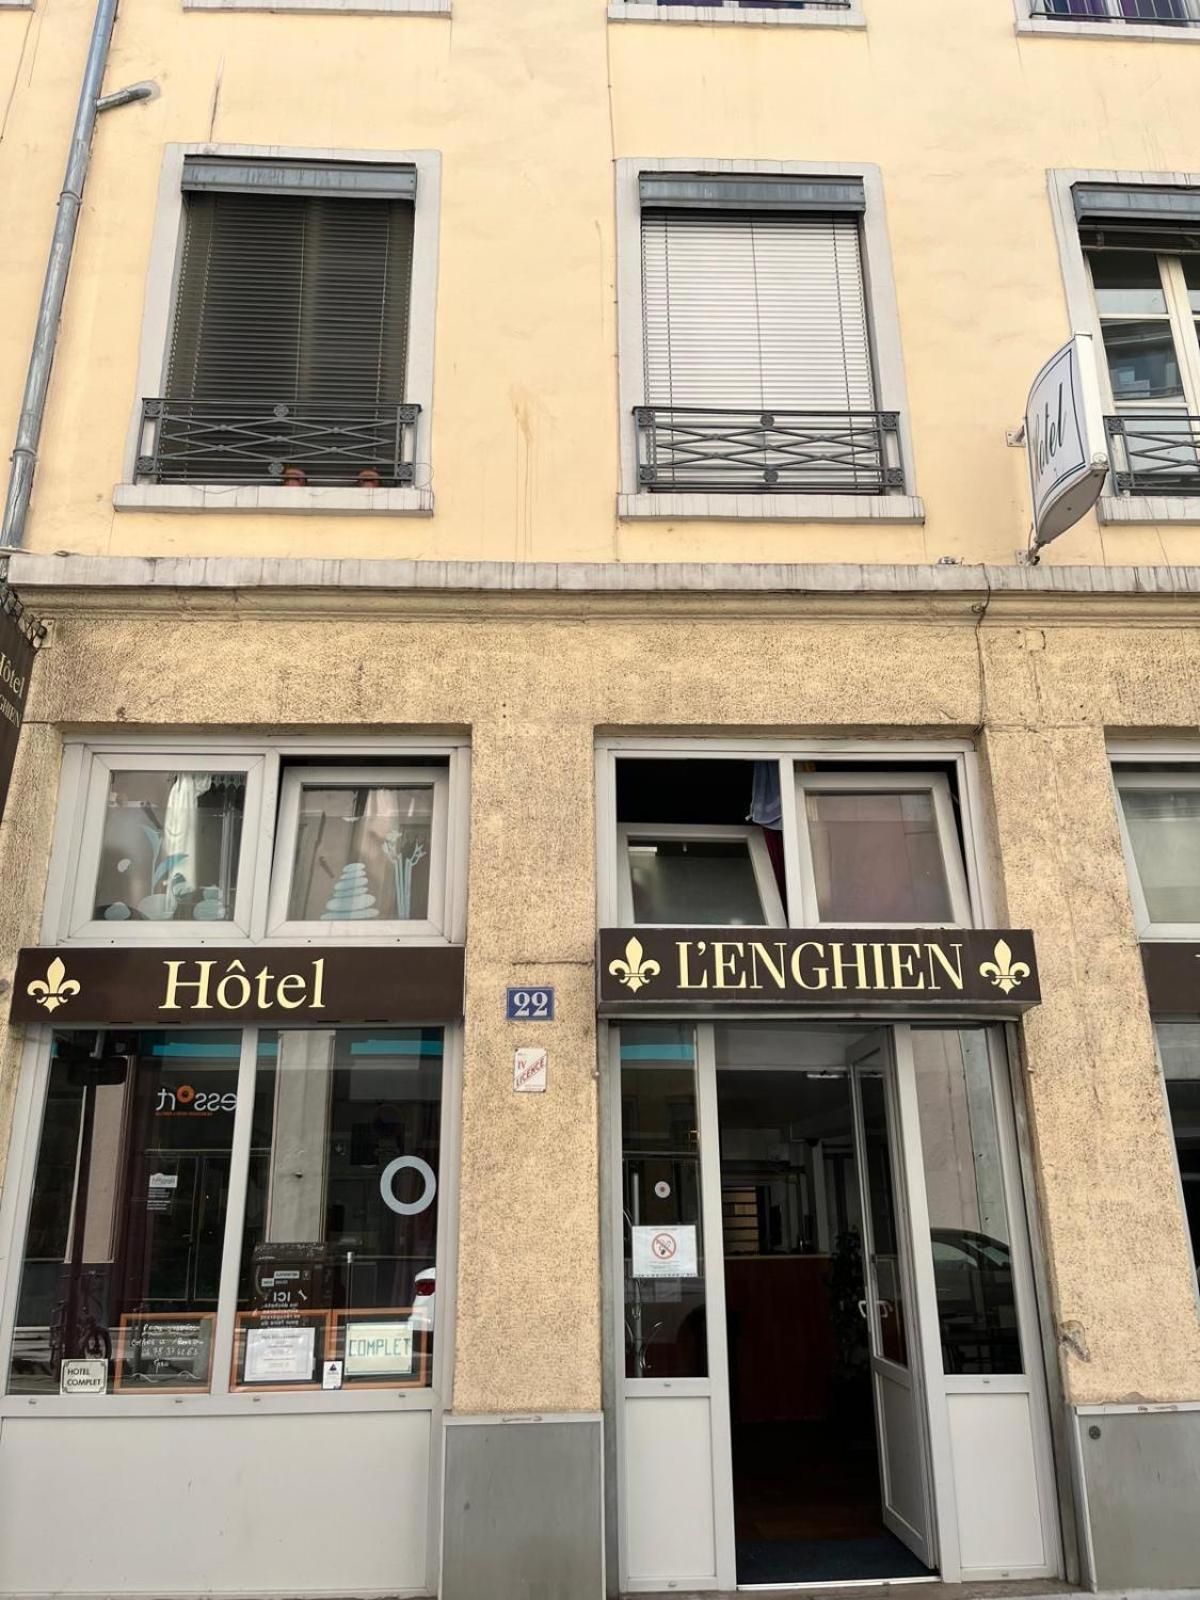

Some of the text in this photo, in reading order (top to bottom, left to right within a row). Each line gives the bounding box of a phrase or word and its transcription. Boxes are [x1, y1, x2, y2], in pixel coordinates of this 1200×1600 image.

[675, 941, 964, 990] L'ENGHIEN
[158, 958, 326, 1010] Hôtel
[513, 991, 548, 1017] 22
[516, 1057, 545, 1087] LICENCE
[348, 1338, 411, 1356] COMPLET
